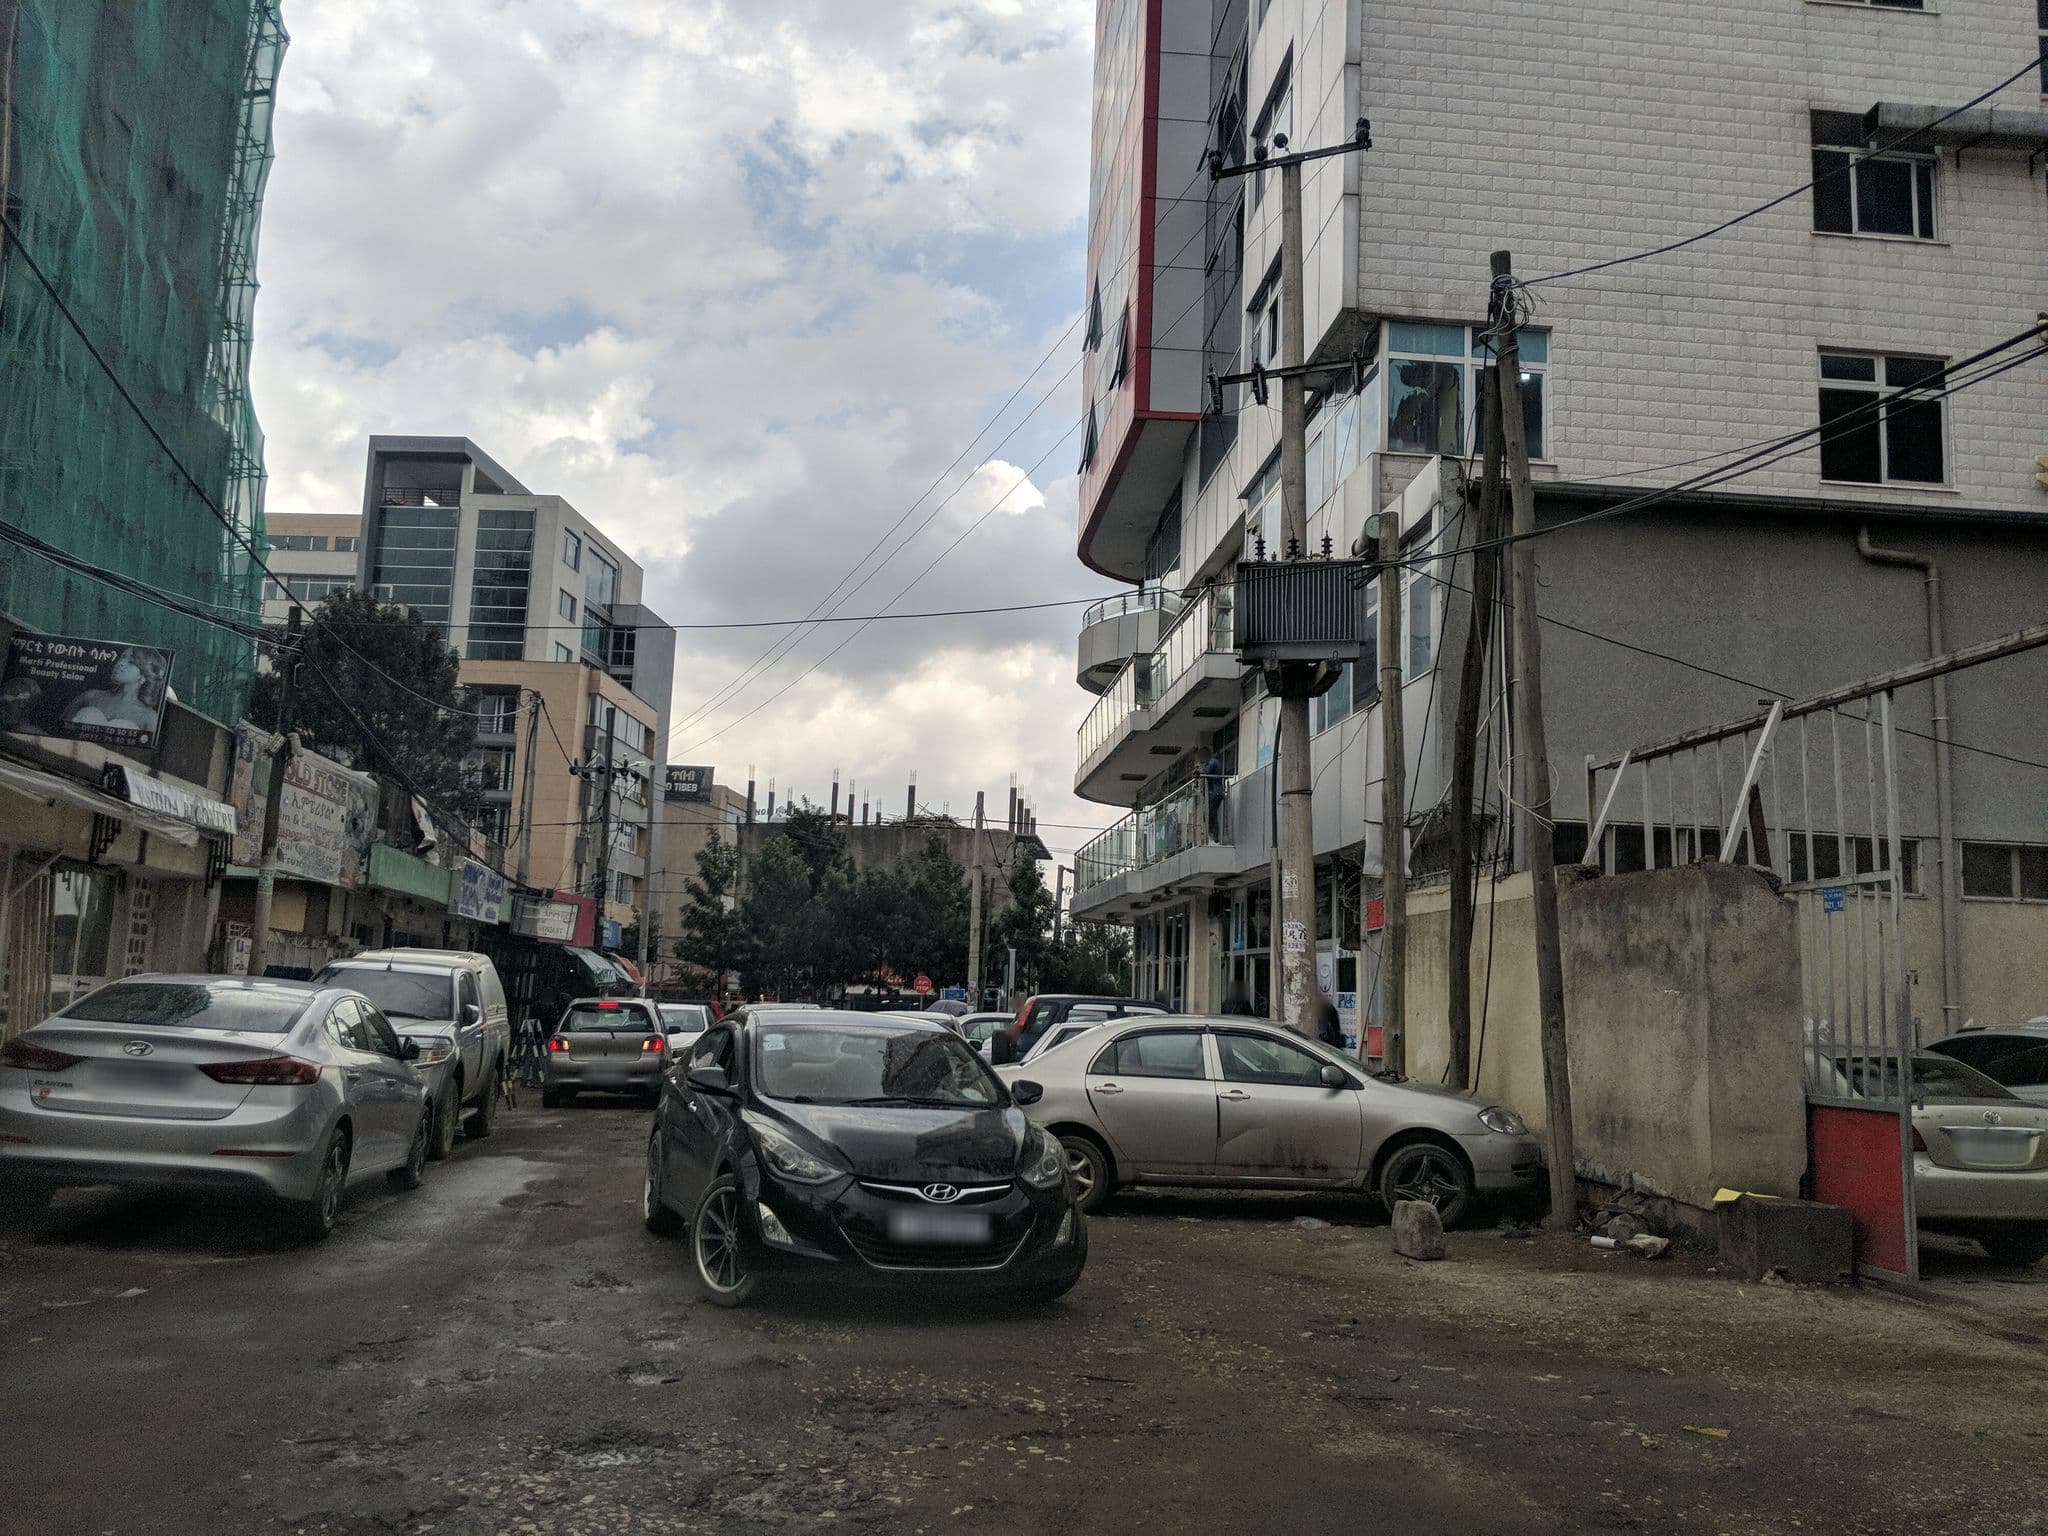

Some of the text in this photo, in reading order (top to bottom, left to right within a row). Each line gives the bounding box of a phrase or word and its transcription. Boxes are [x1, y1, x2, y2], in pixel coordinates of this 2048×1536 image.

[46, 658, 98, 673] Professional
[30, 667, 85, 681] Beauty Salon
[674, 782, 698, 792] TIBEB
